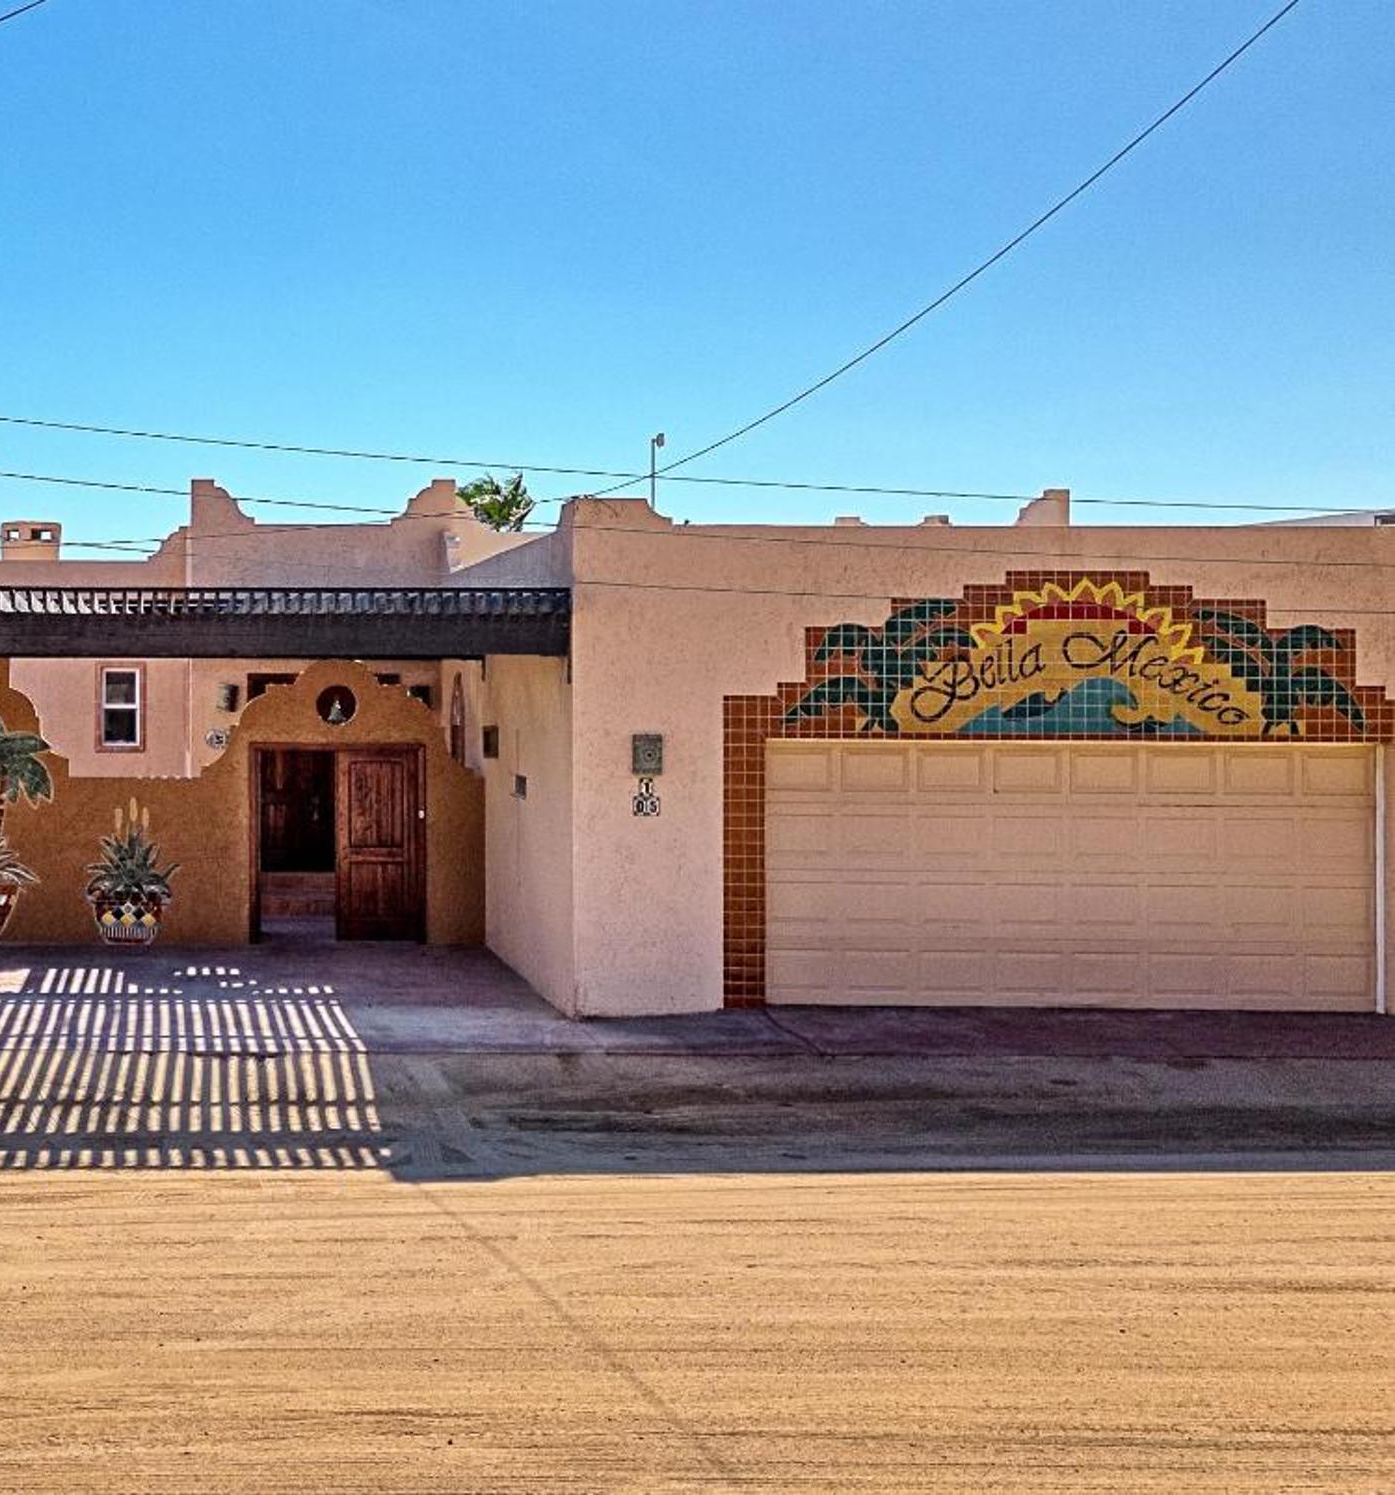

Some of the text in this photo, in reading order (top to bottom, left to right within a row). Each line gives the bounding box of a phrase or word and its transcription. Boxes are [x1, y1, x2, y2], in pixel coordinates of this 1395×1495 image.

[910, 630, 1250, 725] Bella Mexico
[636, 800, 658, 813] 05
